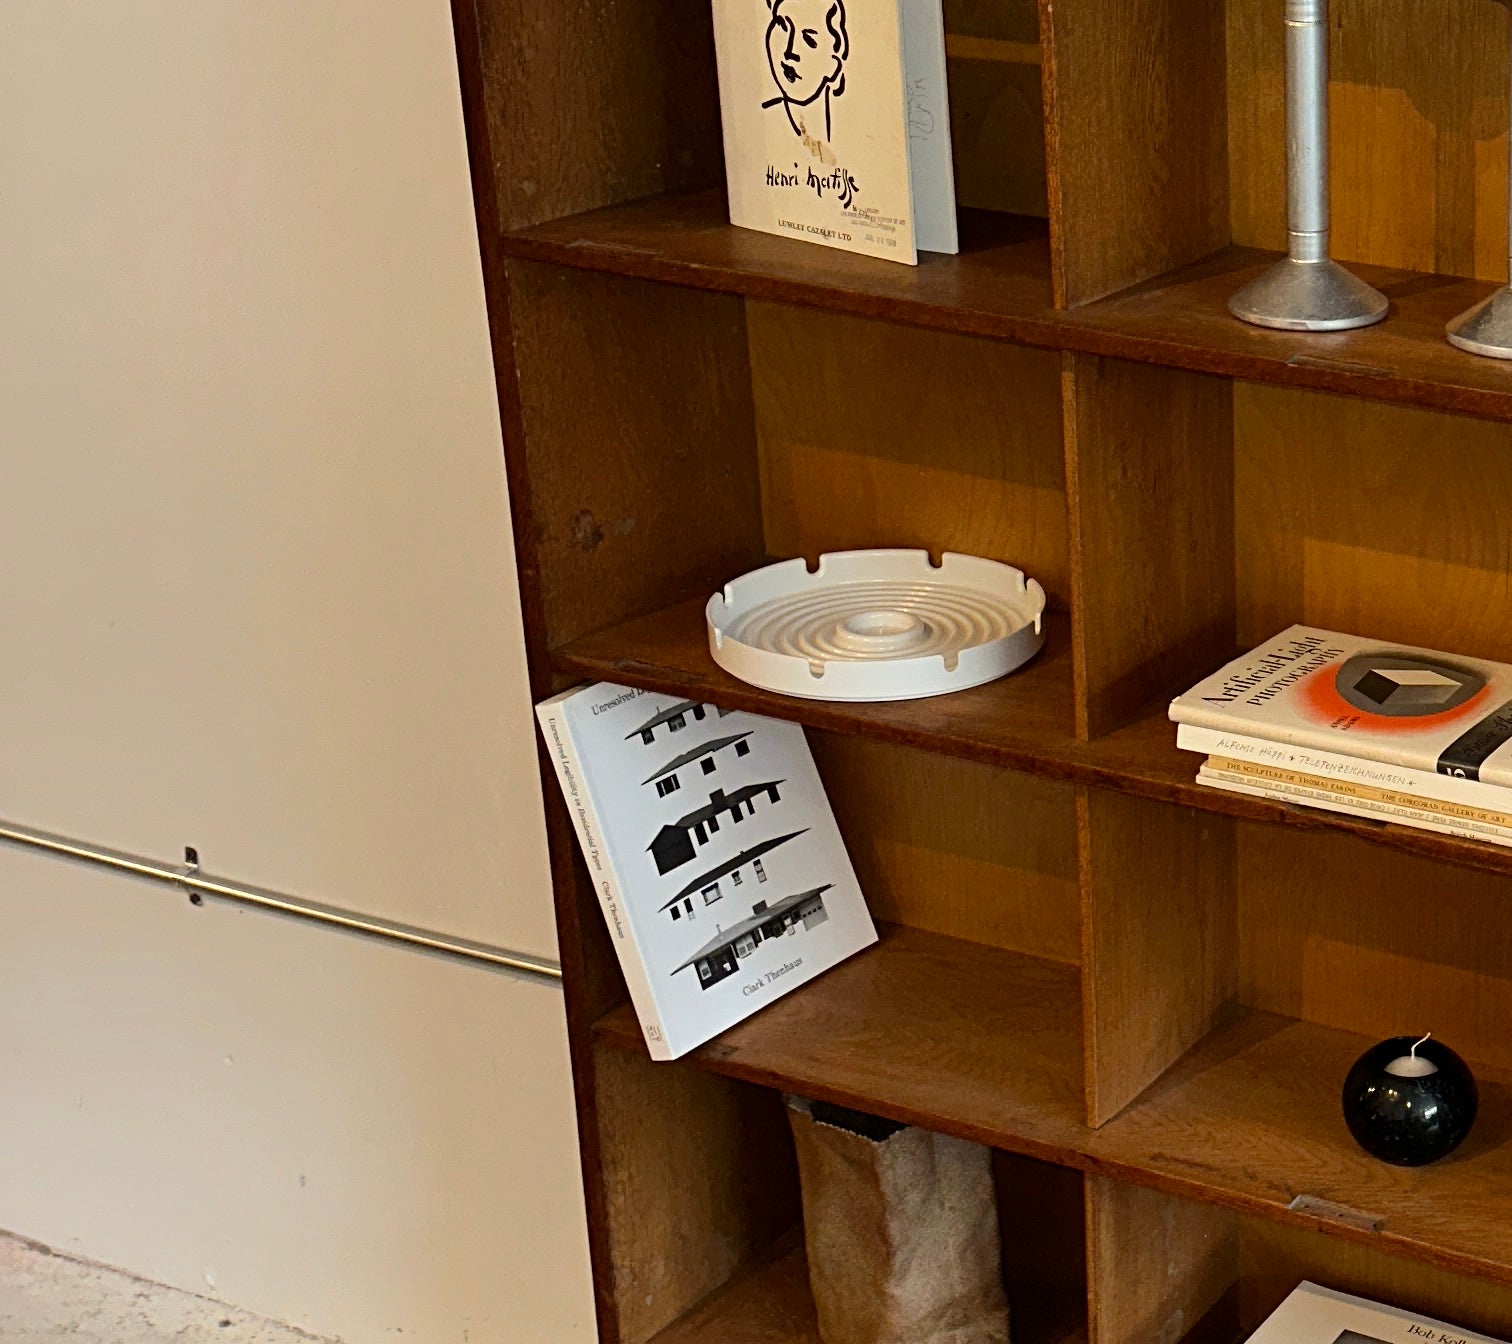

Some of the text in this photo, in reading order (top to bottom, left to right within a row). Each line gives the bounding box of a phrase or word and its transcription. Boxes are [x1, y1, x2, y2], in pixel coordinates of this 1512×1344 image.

[766, 162, 799, 187] Henri
[1246, 649, 1345, 706] PHOTOGRAPHY
[591, 689, 635, 715] Unresolved
[1226, 762, 1241, 770] THE
[1407, 1324, 1435, 1340] Bob
